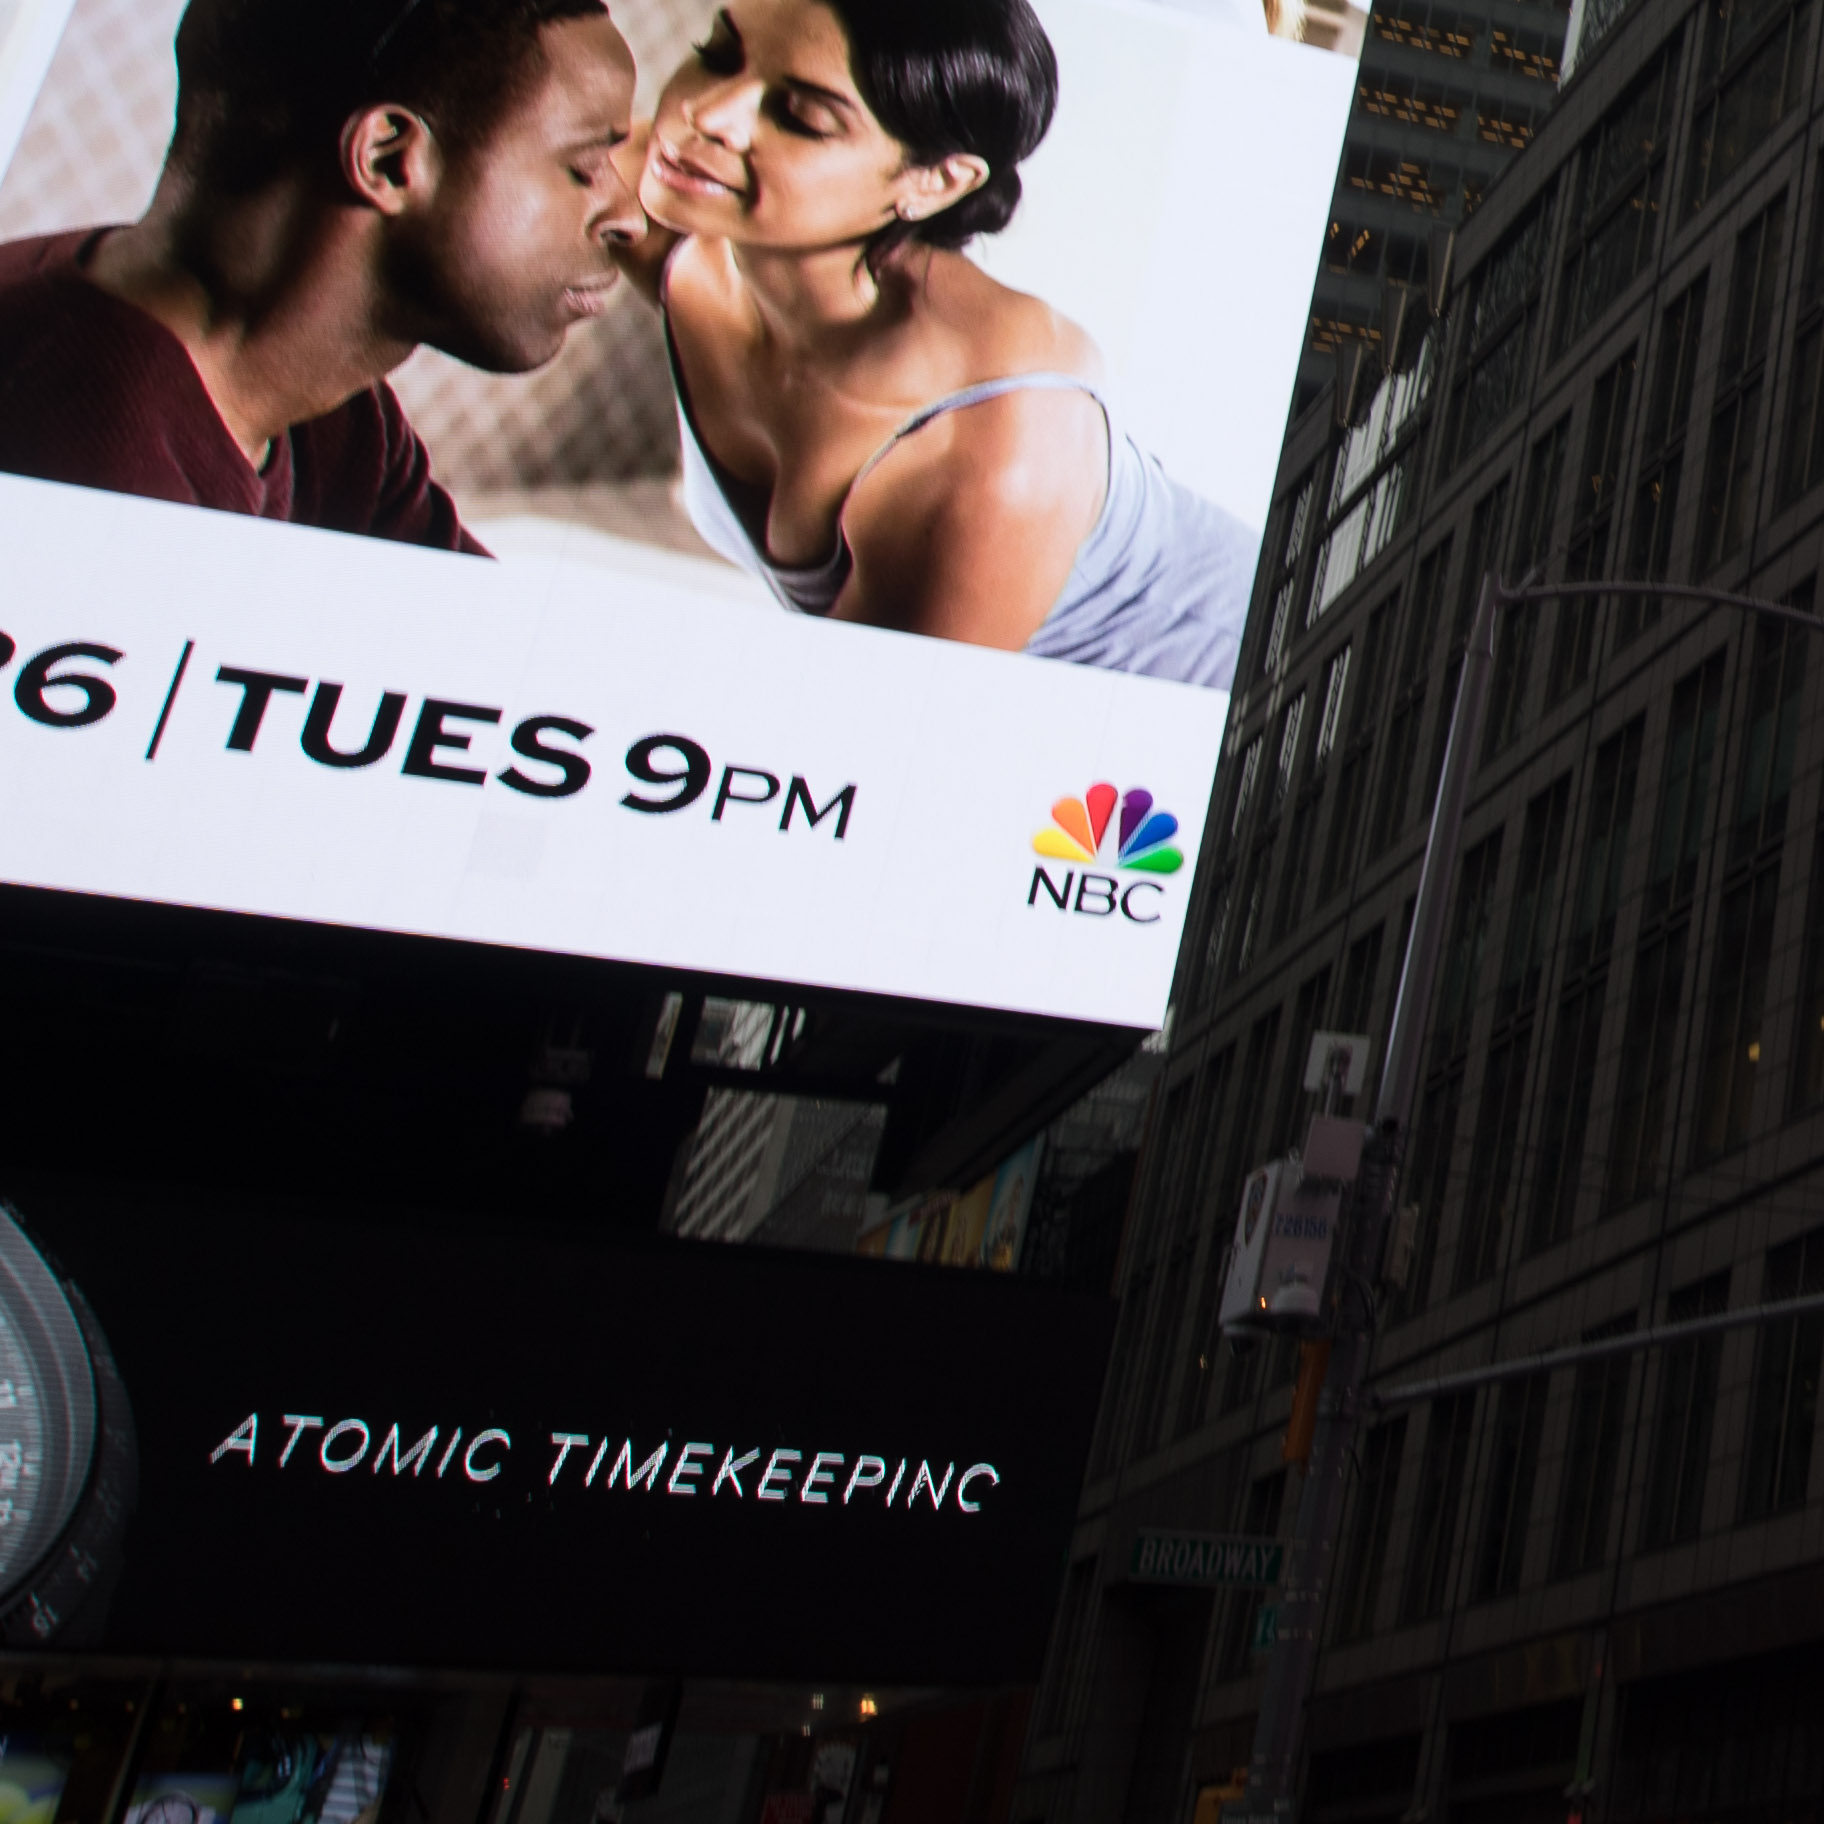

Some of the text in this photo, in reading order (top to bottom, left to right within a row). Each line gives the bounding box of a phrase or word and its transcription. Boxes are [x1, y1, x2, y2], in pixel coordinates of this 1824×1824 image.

[0, 630, 859, 842] 6 TUES 9PM
[1027, 865, 1166, 926] NBC
[209, 1411, 513, 1484] ATOMIC
[1138, 1536, 1275, 1581] BROADWAY
